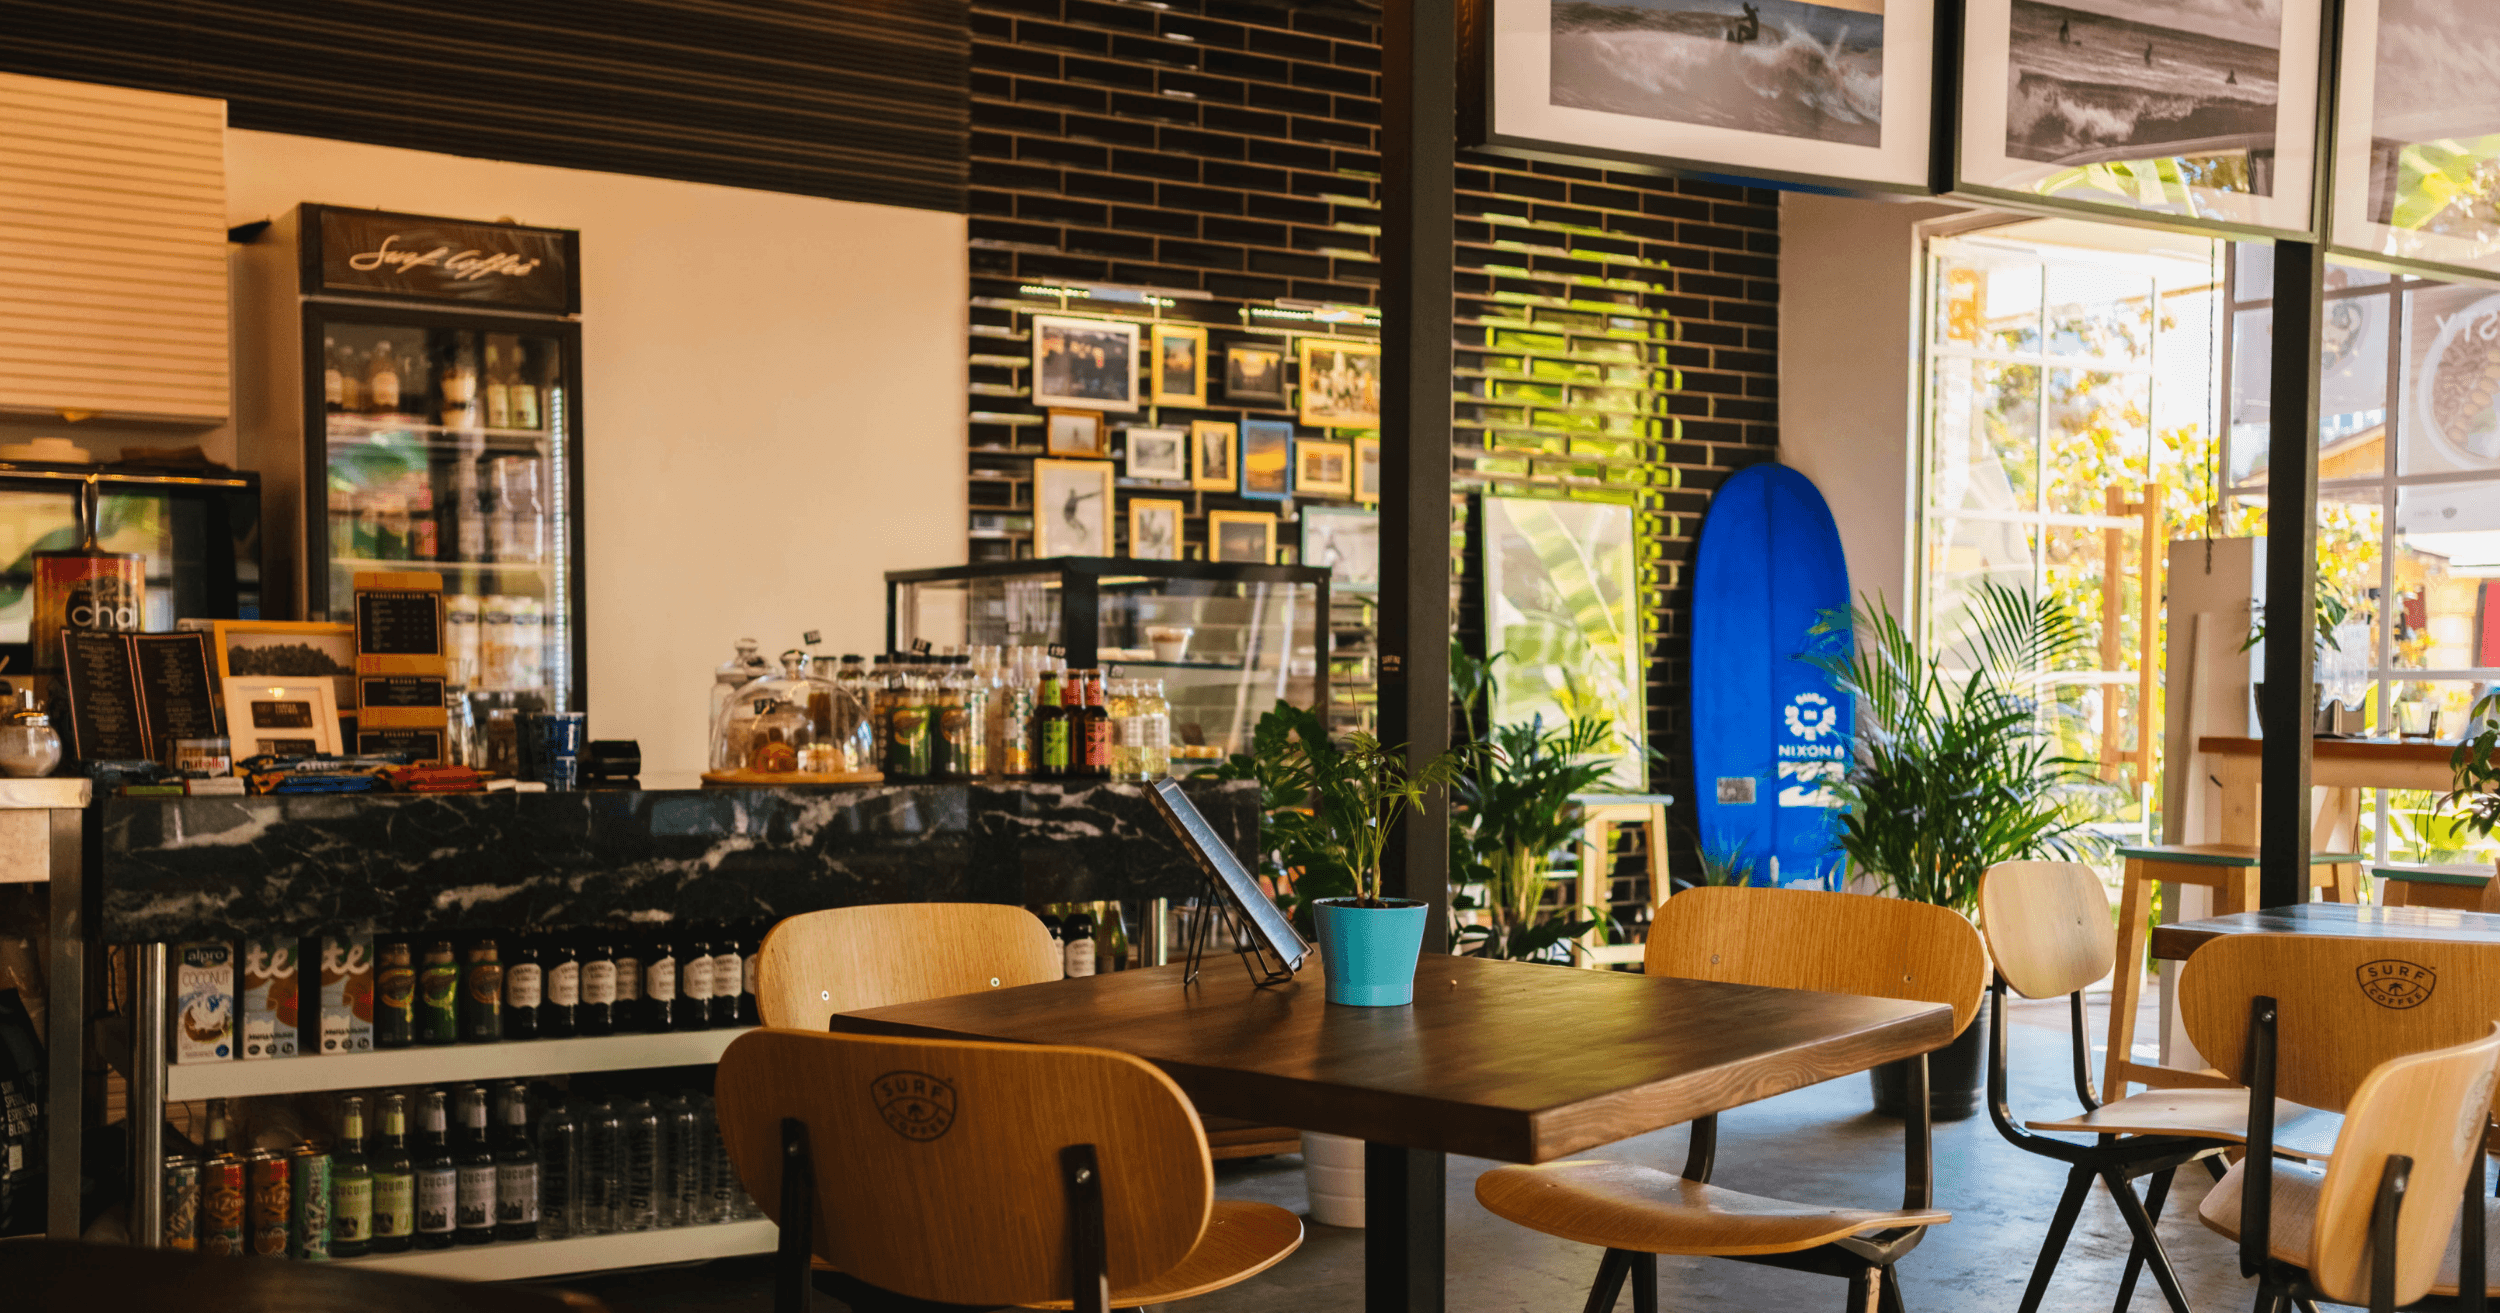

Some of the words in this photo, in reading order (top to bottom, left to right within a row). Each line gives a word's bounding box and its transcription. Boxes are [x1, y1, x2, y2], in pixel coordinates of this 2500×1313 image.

[1778, 744, 1832, 758] NIXON
[187, 948, 225, 965] alpro
[181, 970, 230, 987] COCONUT
[2367, 964, 2426, 980] SURF
[2369, 987, 2423, 1006] COFFEE
[881, 1077, 944, 1098] SURF
